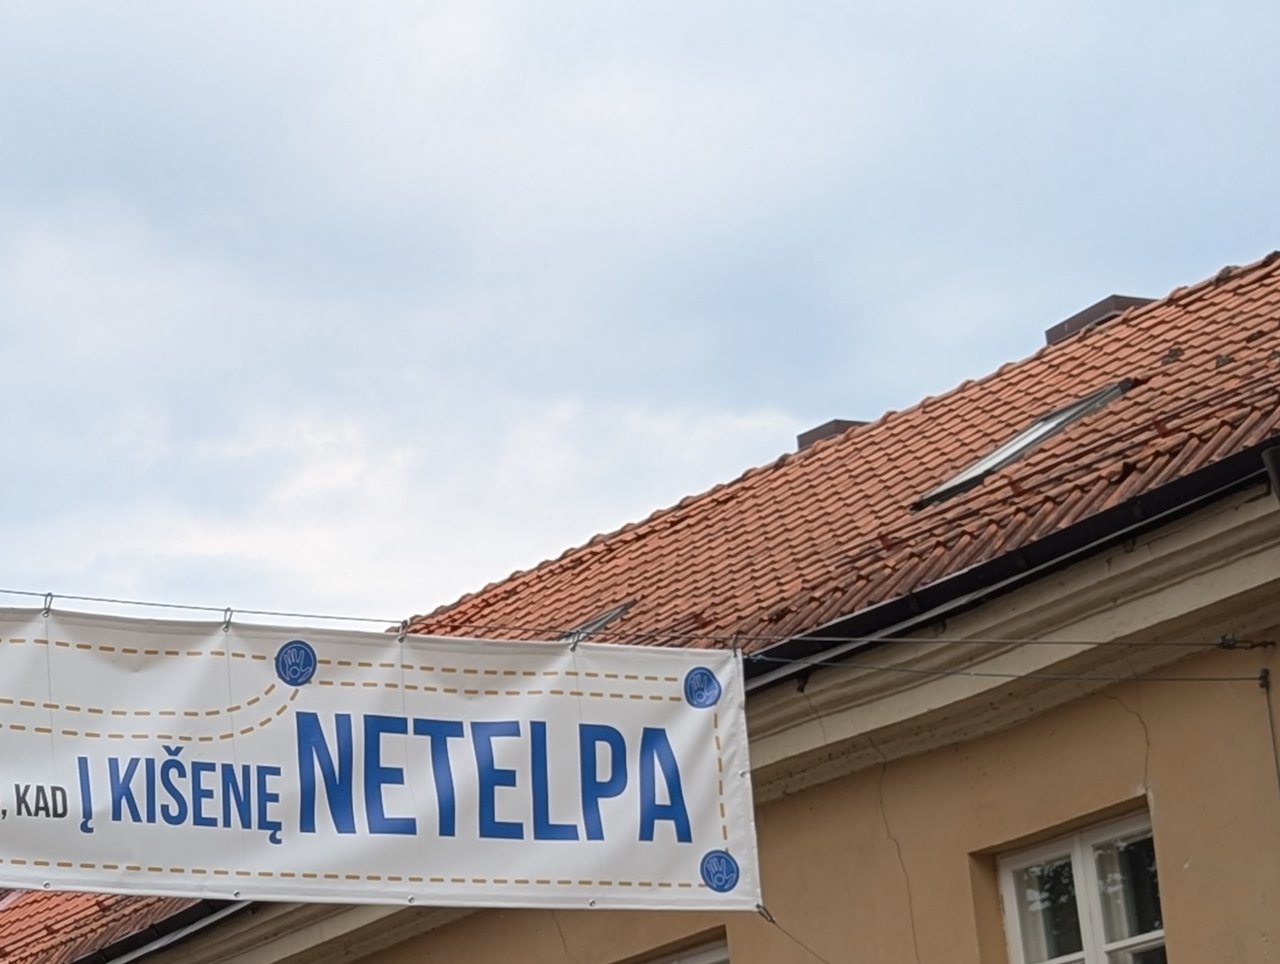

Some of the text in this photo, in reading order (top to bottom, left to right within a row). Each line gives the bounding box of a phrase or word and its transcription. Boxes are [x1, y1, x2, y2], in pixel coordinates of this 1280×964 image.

[15, 783, 68, 819] KAD
[76, 756, 95, 833] Į
[108, 745, 283, 845] KIŠENĘ
[295, 711, 693, 844] NETELPA
